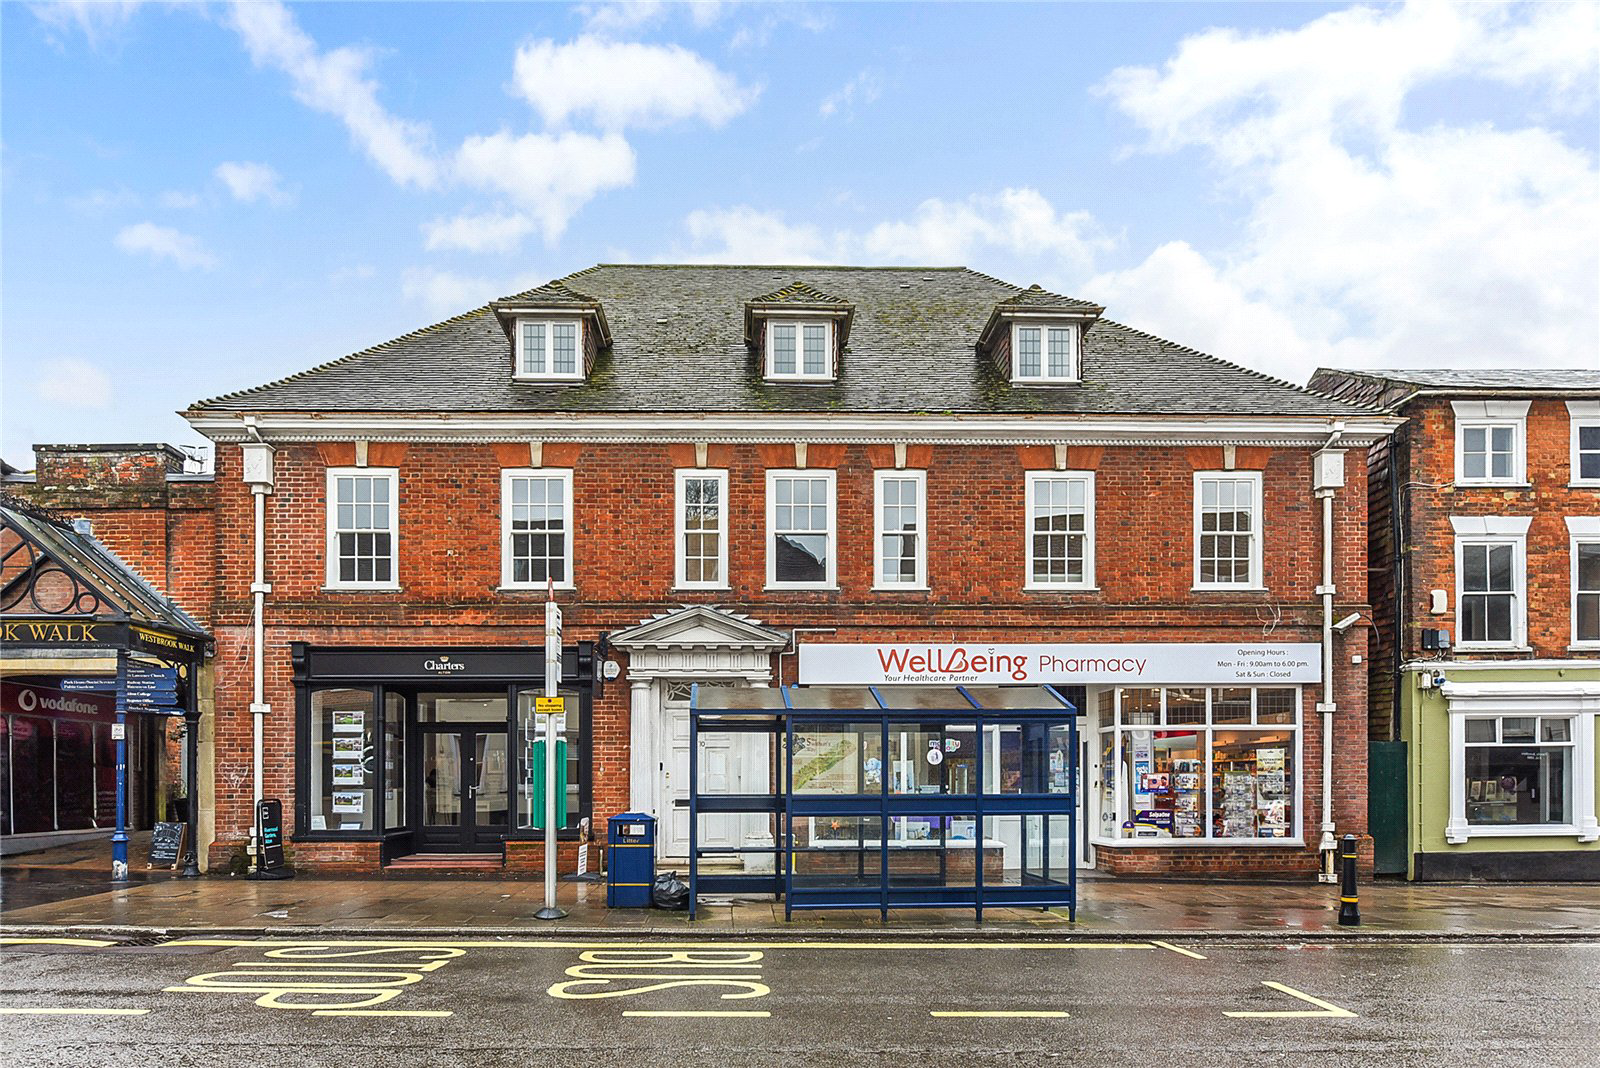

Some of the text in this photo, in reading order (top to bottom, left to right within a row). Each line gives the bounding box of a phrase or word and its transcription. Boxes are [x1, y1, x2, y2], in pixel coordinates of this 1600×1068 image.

[0, 623, 98, 641] K WALK
[139, 632, 195, 653] WESTBROOK WALK
[1237, 649, 1266, 657] Opening
[424, 660, 465, 670] Charters
[878, 648, 1147, 681] WellBeing Pharmacy
[884, 674, 978, 682] Your Healthcare Partner
[40, 696, 98, 714] vodafone
[547, 951, 771, 999] BUS
